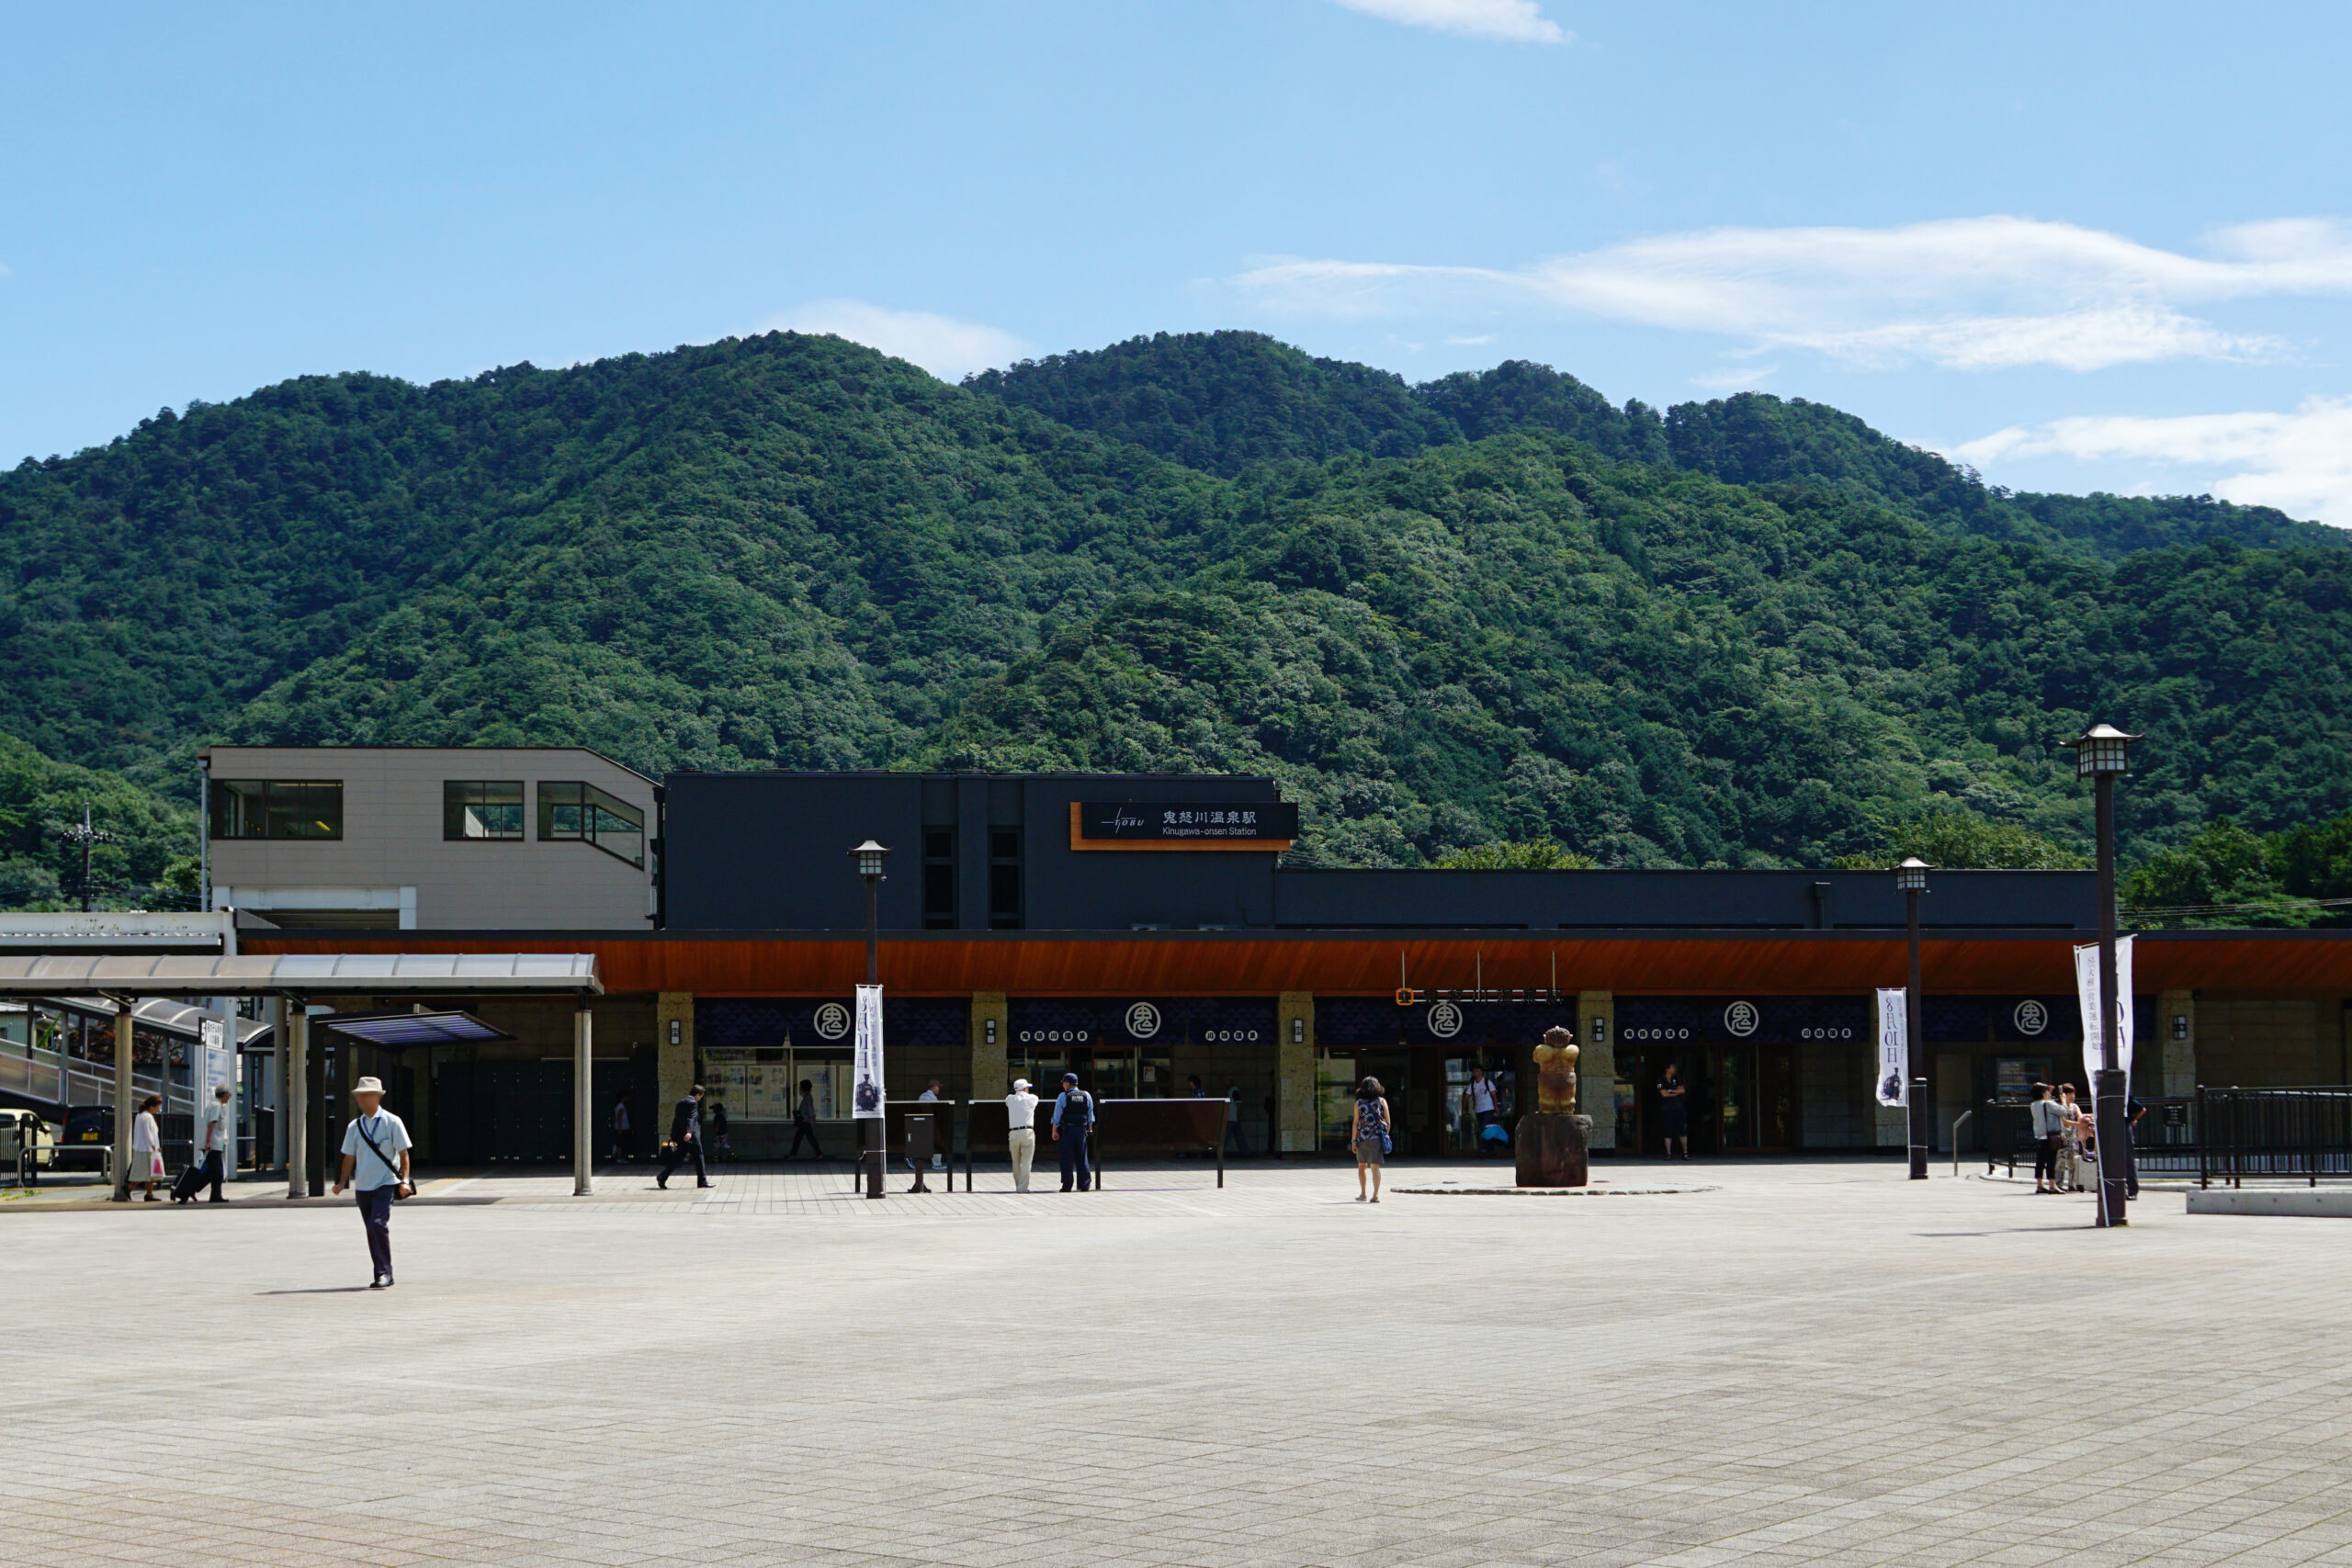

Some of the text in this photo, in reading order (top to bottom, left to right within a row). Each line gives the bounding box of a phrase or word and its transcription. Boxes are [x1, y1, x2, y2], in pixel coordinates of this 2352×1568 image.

[1162, 810, 1257, 824] 鬼怒川温泉駅
[1162, 827, 1257, 837] Kinugawa-onsen Station
